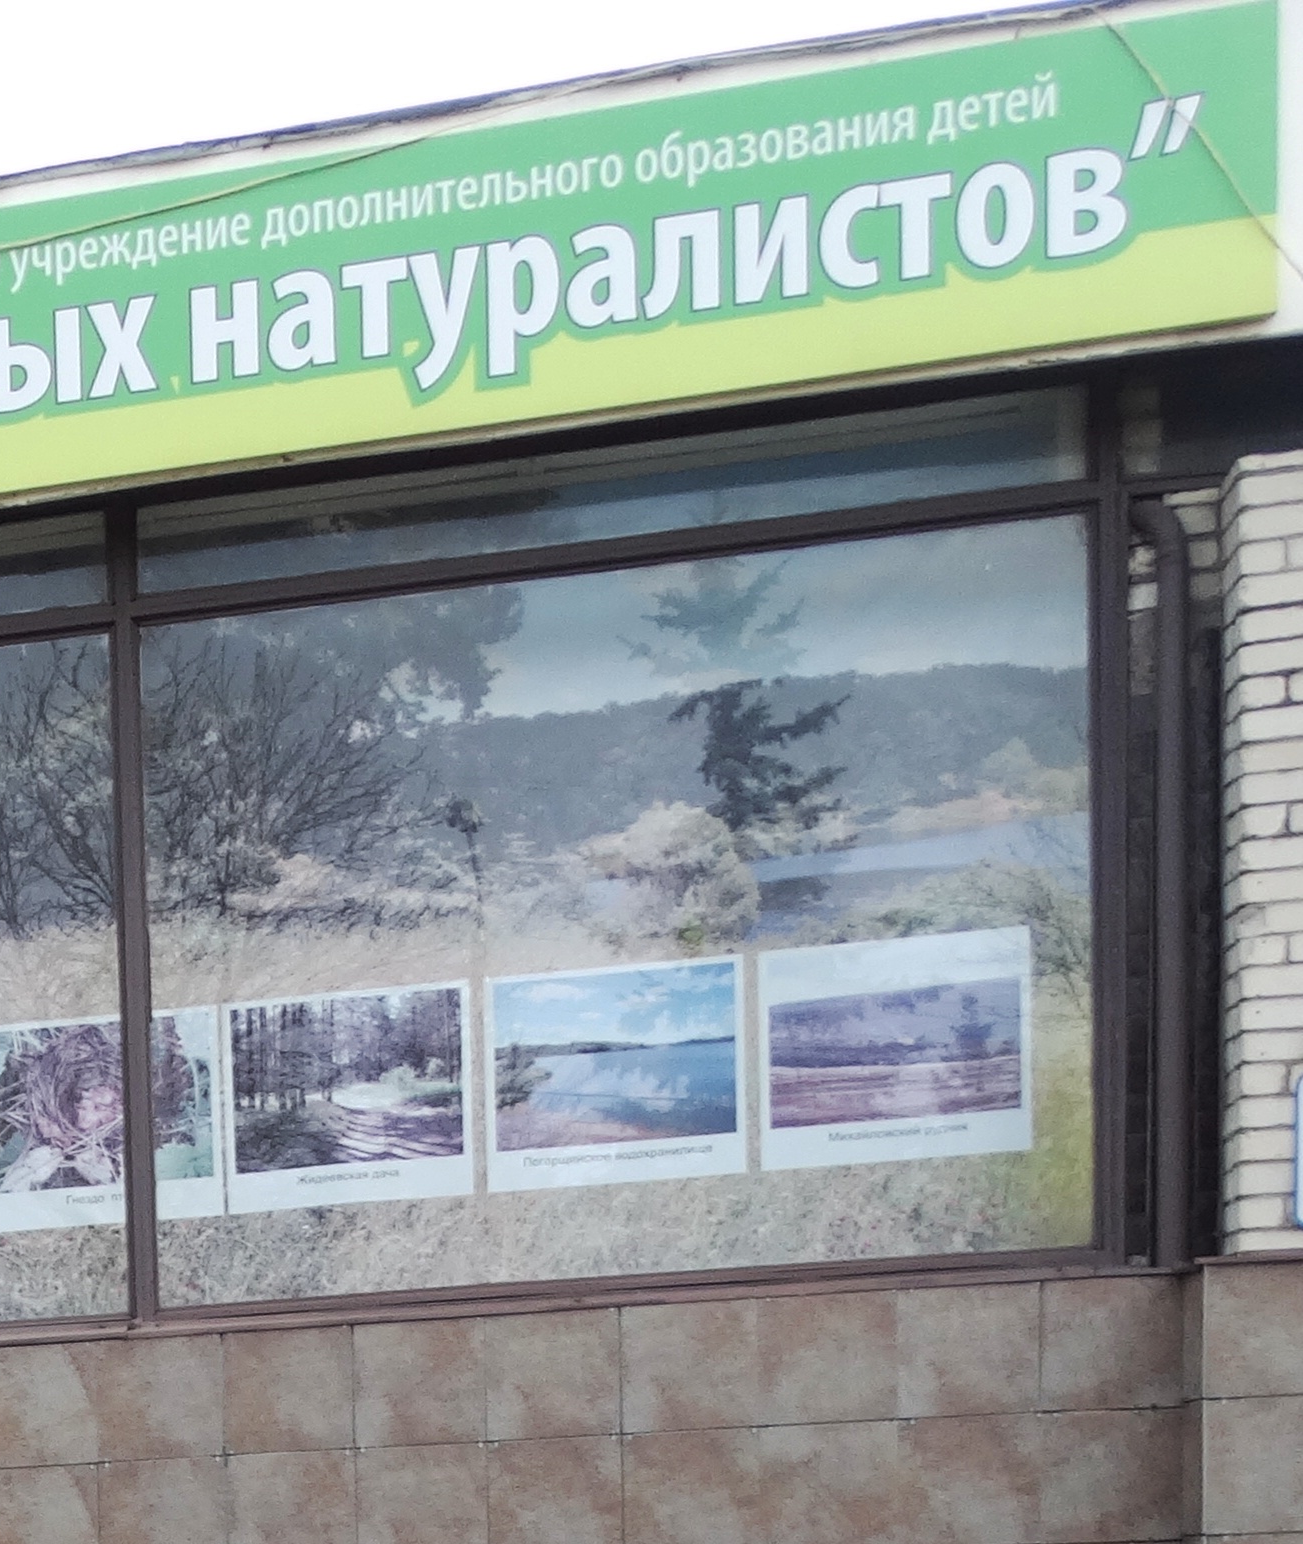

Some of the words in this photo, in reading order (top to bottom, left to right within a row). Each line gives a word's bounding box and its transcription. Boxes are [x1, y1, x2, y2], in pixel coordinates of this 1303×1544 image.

[7, 211, 251, 293] учреждение
[261, 152, 623, 249] дополнительного
[634, 108, 916, 188] образования
[927, 74, 1060, 146] детей
[65, 1194, 106, 1206] Гнездо
